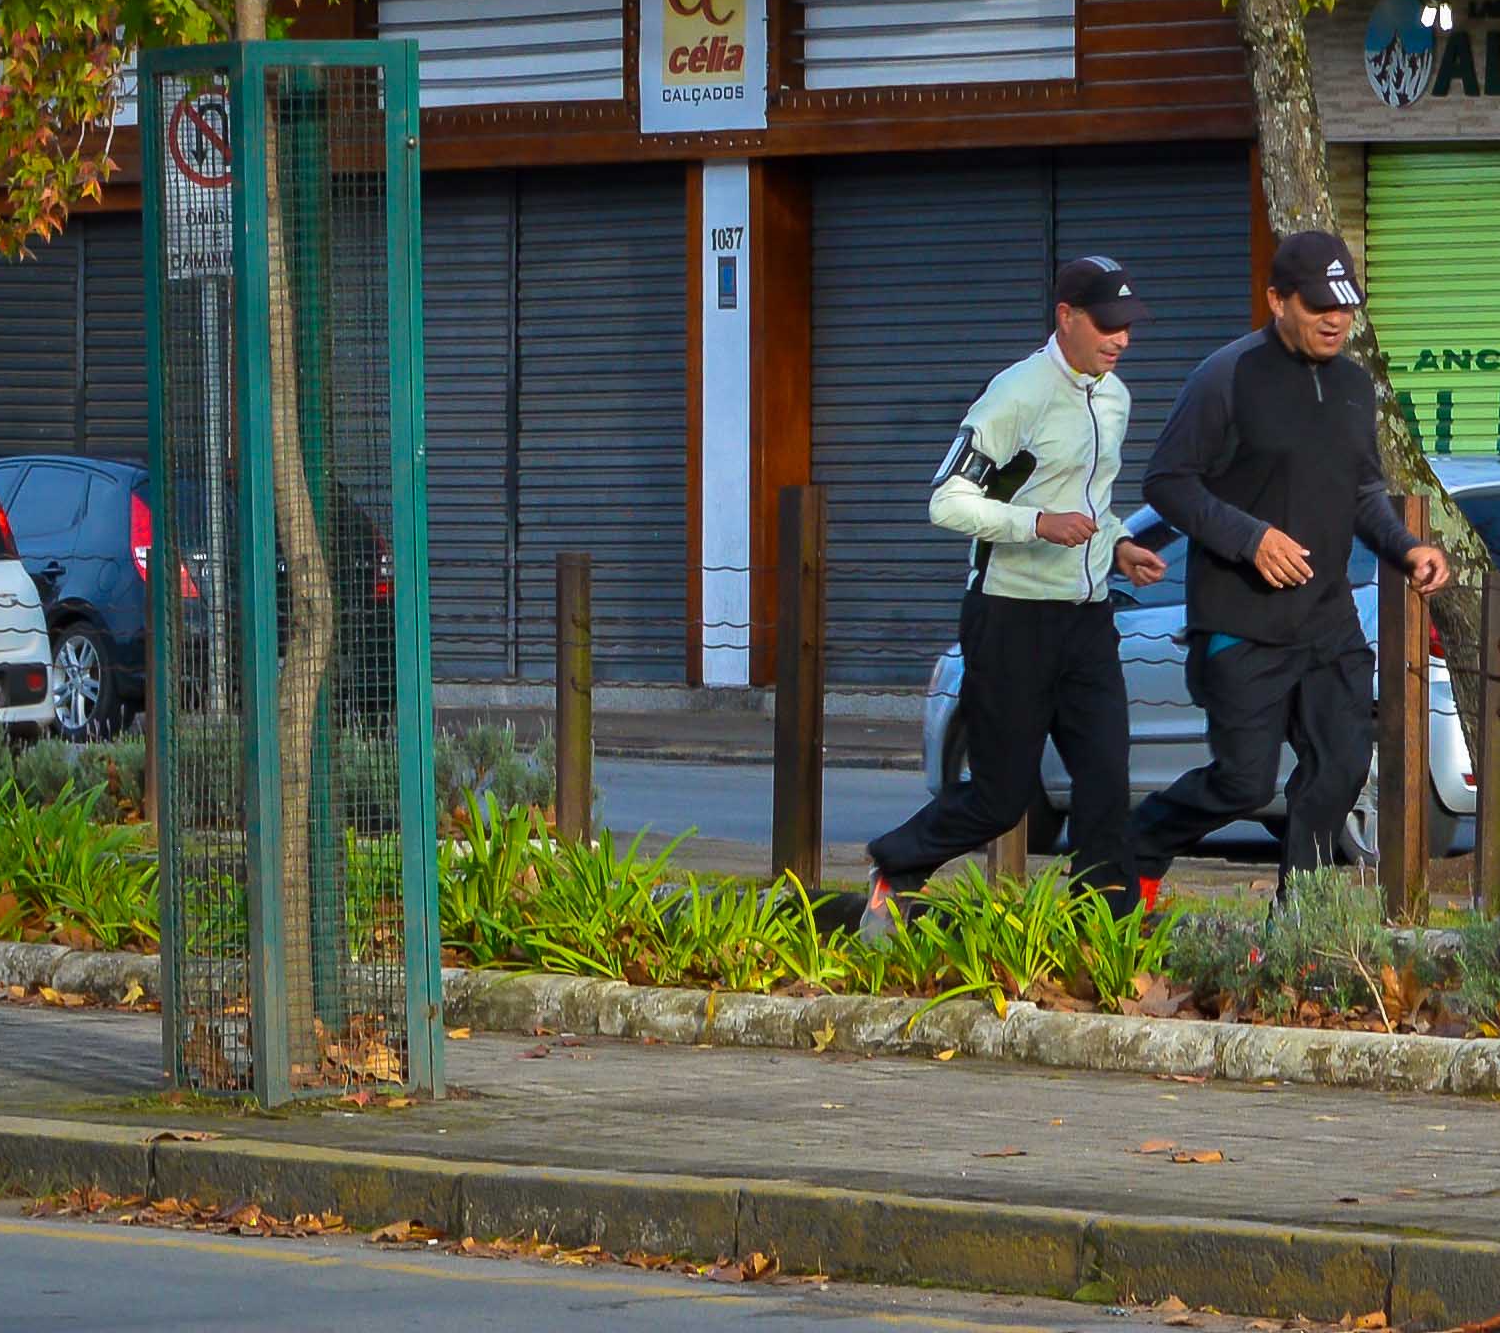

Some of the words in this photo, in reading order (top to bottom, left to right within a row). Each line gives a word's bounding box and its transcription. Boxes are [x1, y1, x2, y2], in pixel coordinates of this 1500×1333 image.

[668, 35, 744, 75] célia
[662, 85, 745, 106] CALÇADOS
[711, 226, 744, 251] 1037
